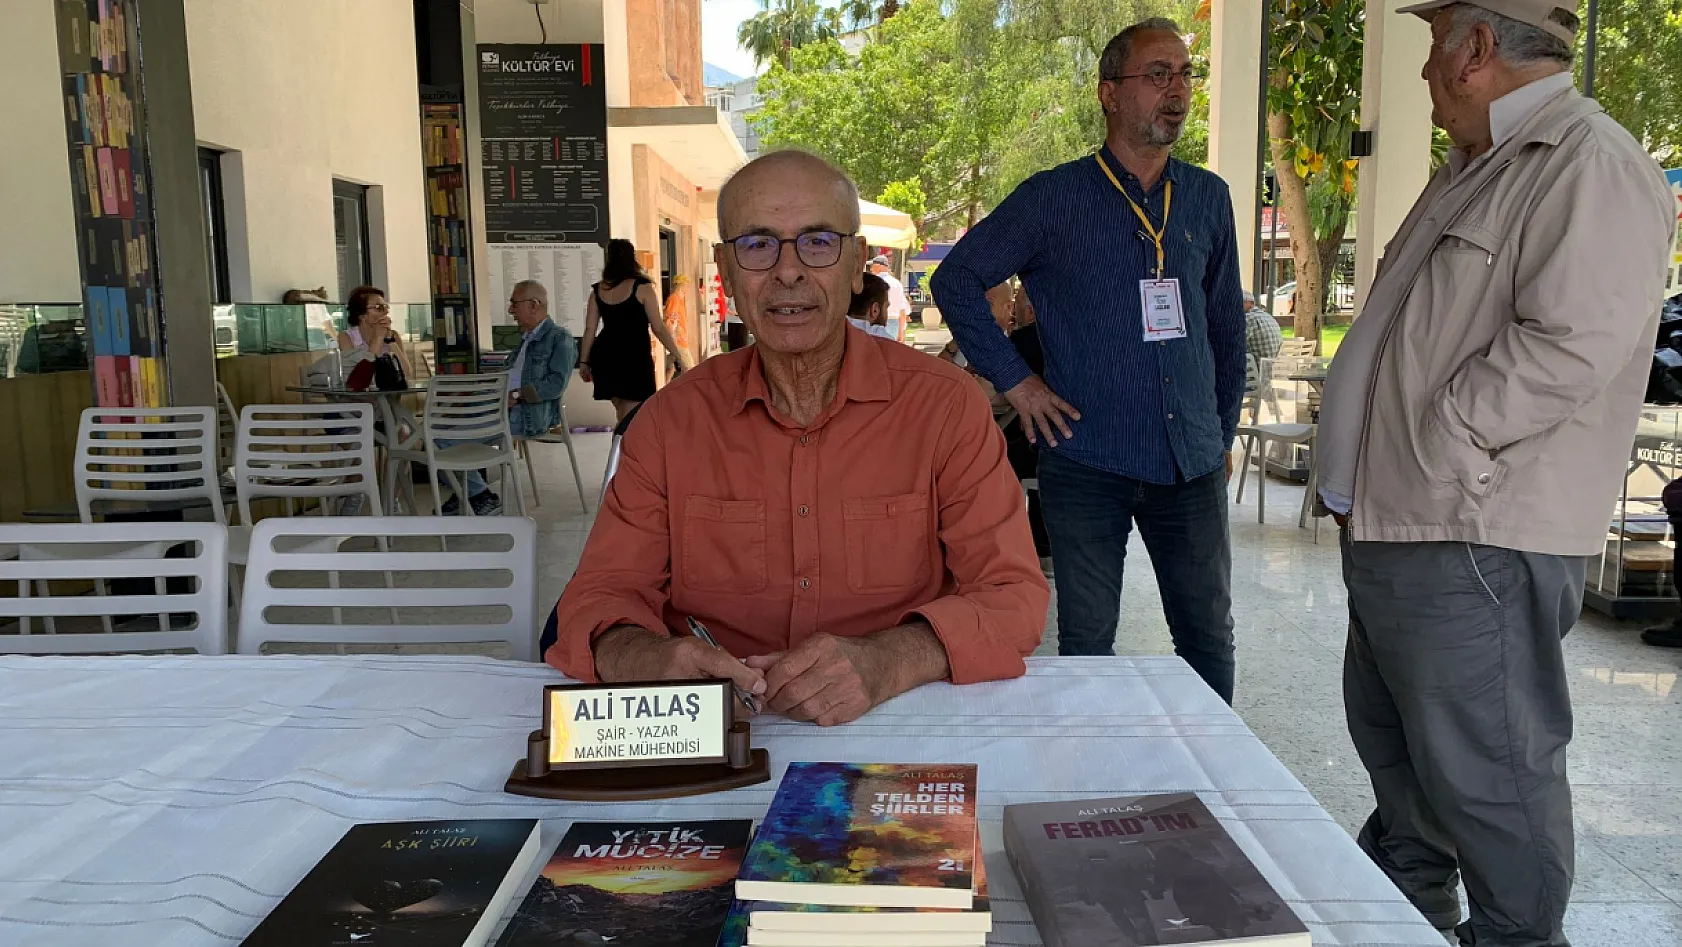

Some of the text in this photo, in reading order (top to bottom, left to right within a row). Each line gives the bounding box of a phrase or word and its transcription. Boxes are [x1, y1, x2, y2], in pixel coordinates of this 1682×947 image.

[502, 60, 550, 72] KÜLTÜR
[555, 59, 575, 72] EVİ
[574, 692, 700, 722] ALİ TALAŞ
[596, 725, 626, 742] ŞAİR
[636, 724, 679, 739] YAZAR
[574, 738, 700, 759] MAKİNE MÜHENDİSİ
[918, 782, 965, 792] HER
[874, 792, 965, 803] TELDEN
[611, 826, 704, 844] YİTİK
[573, 842, 725, 860] MUCİZE
